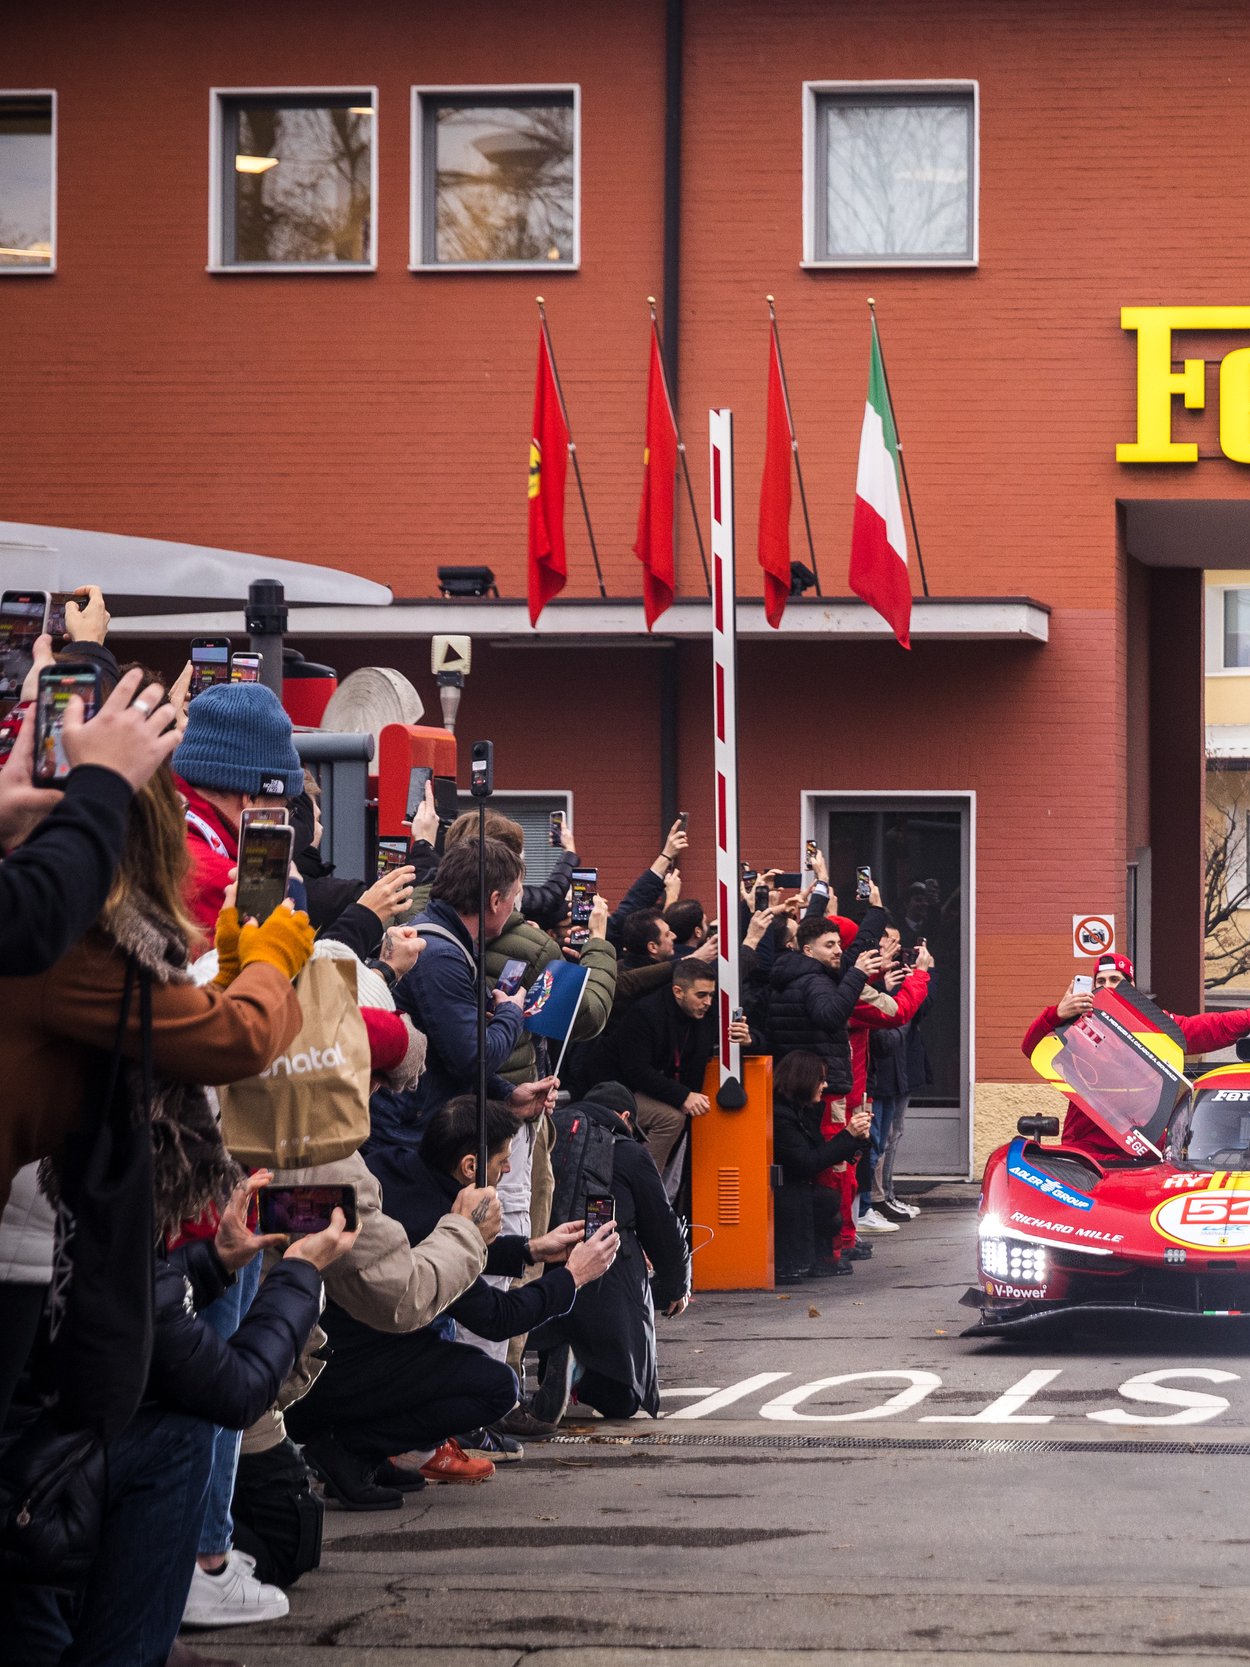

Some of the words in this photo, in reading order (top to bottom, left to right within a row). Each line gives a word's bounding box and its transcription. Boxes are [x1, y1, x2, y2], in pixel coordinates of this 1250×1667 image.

[259, 1041, 346, 1077] natal
[1009, 1167, 1043, 1186] ADLER
[1052, 1189, 1090, 1208] GROUP
[1010, 1211, 1074, 1234] RICHARD
[1075, 1228, 1125, 1243] MILLE
[994, 1284, 1047, 1299] V-Power
